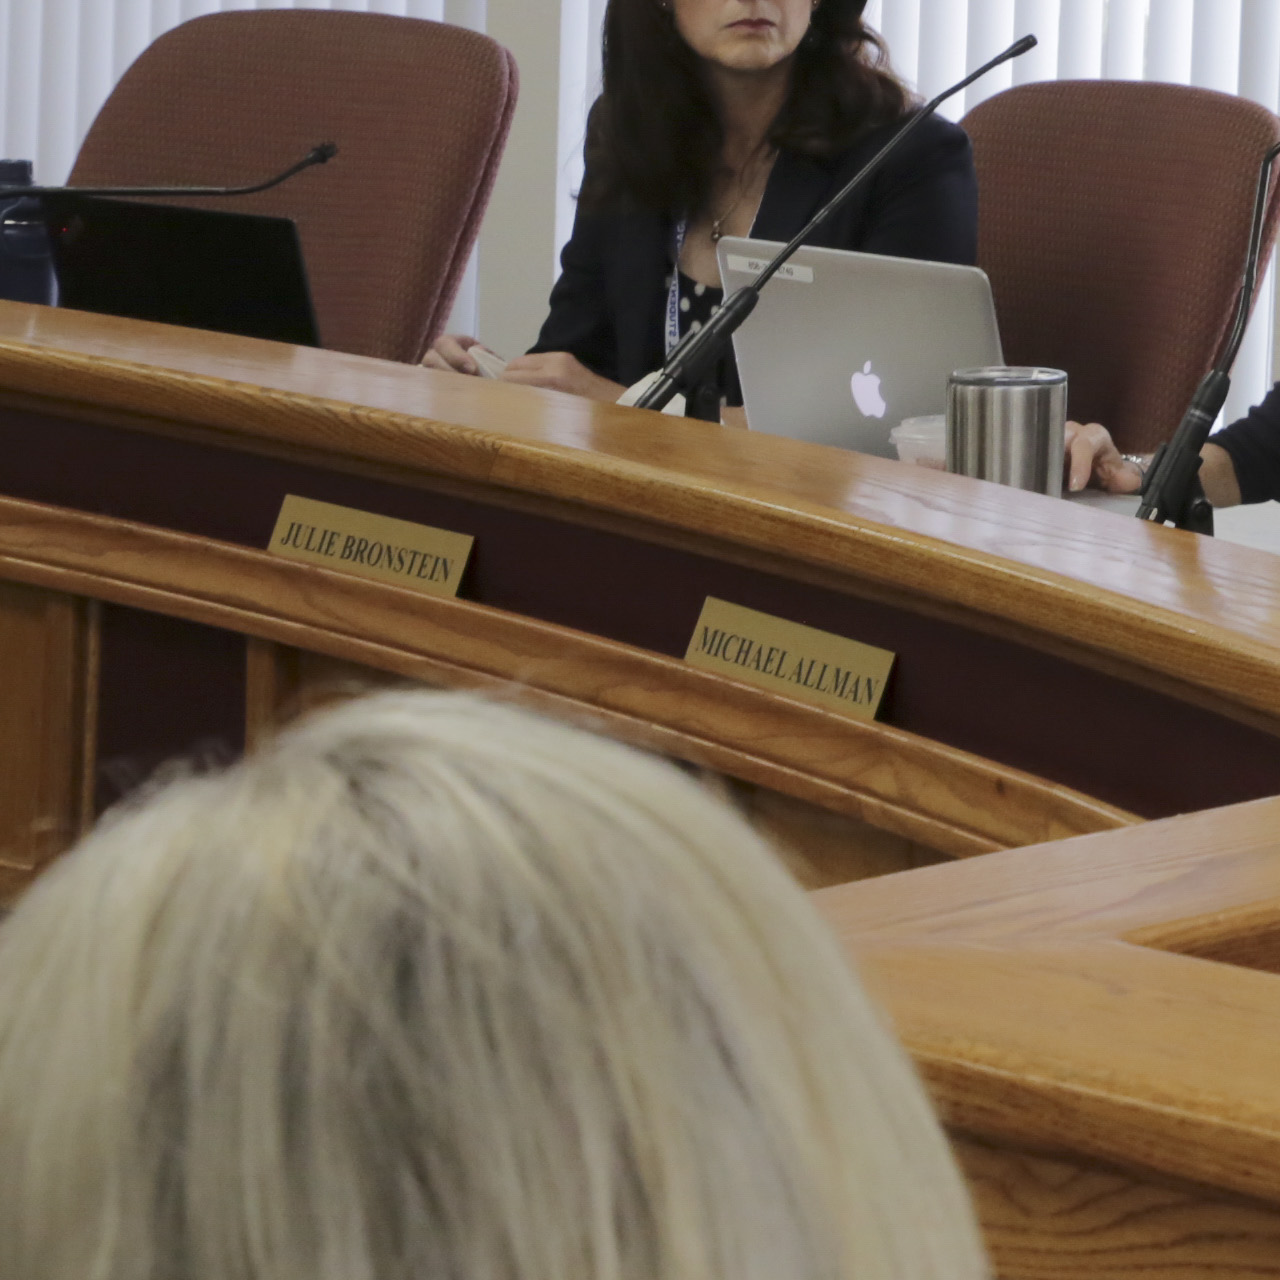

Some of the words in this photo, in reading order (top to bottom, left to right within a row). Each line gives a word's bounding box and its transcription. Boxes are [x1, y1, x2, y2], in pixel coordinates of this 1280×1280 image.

[281, 522, 341, 557] JULIE
[340, 535, 454, 583] BRONSTEIN
[695, 626, 788, 679] MICHAEL
[787, 656, 880, 706] ALLMAN
